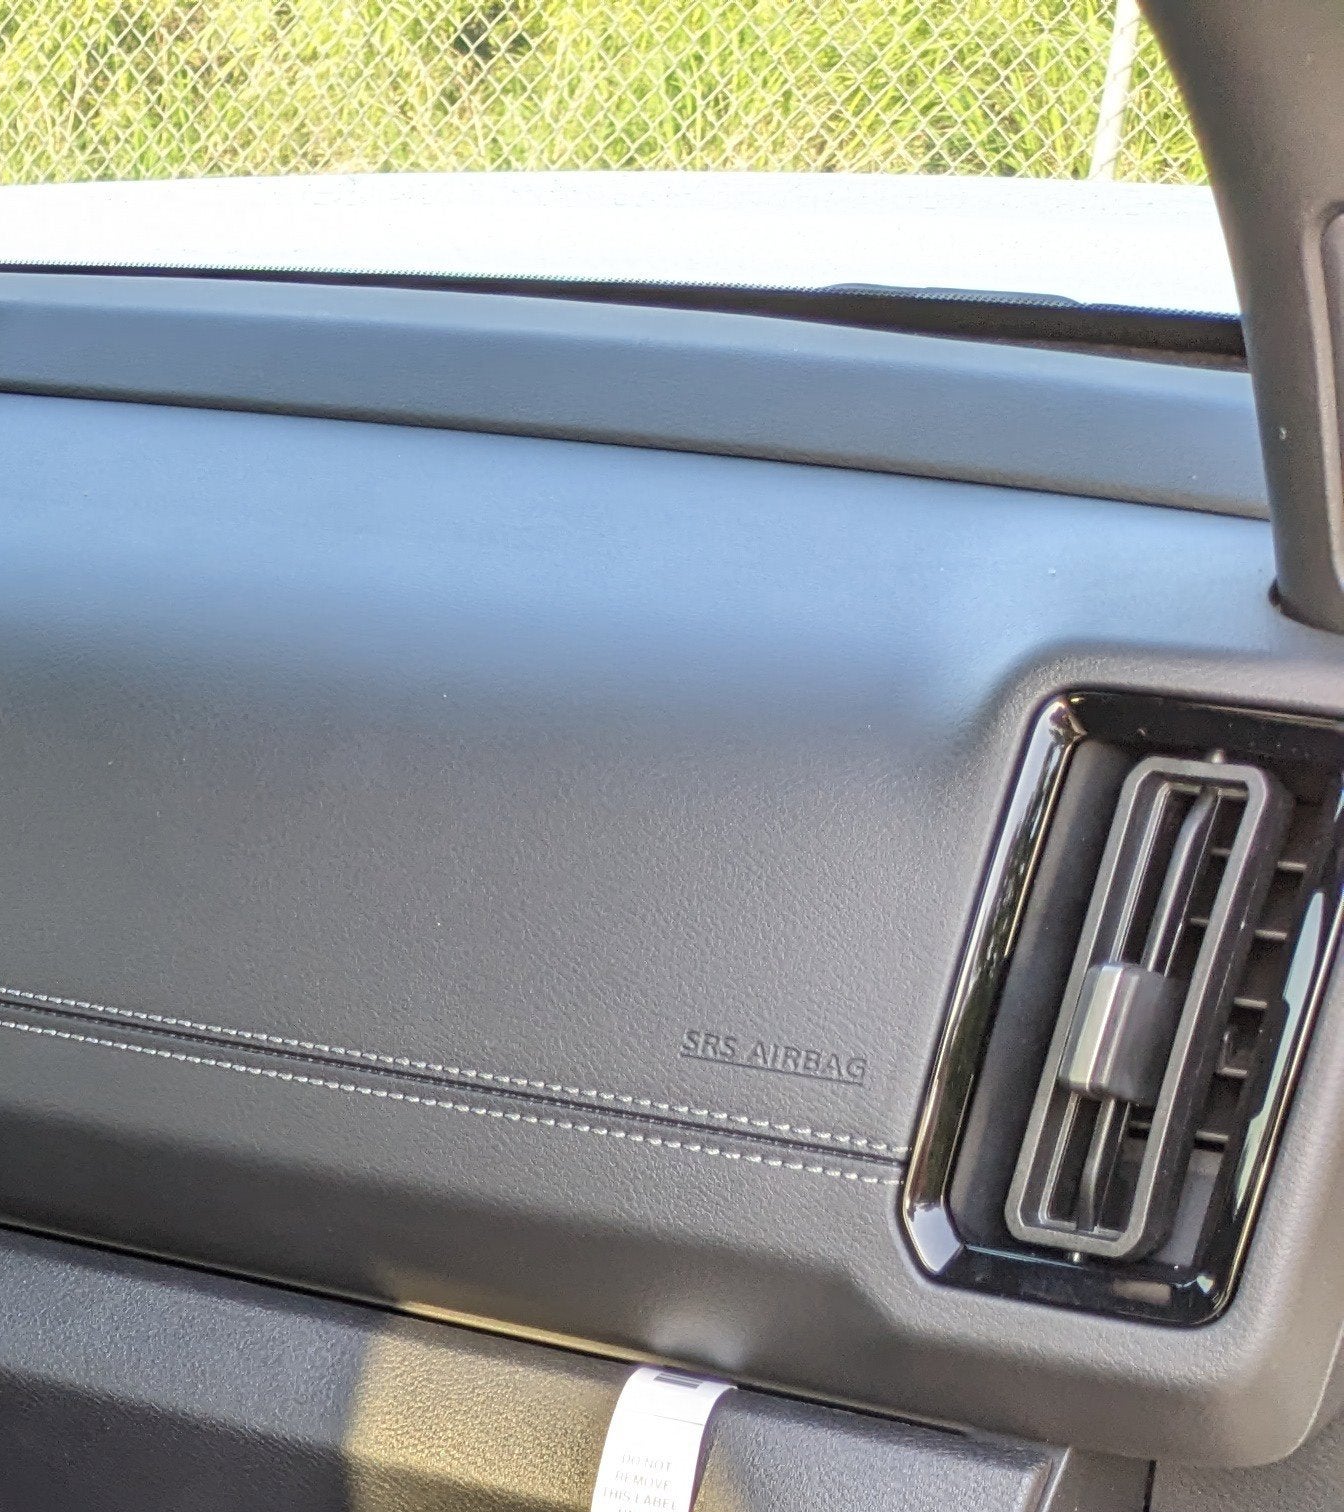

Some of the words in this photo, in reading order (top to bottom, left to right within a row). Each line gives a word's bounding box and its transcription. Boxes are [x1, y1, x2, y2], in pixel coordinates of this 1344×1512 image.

[681, 1029, 739, 1059] SRS
[747, 1040, 869, 1078] AIRBAG
[621, 1453, 641, 1465] DO
[644, 1456, 673, 1473] NOT
[615, 1470, 672, 1492] REMOVE
[603, 1487, 631, 1503] THIS
[635, 1494, 678, 1511] LABEL
